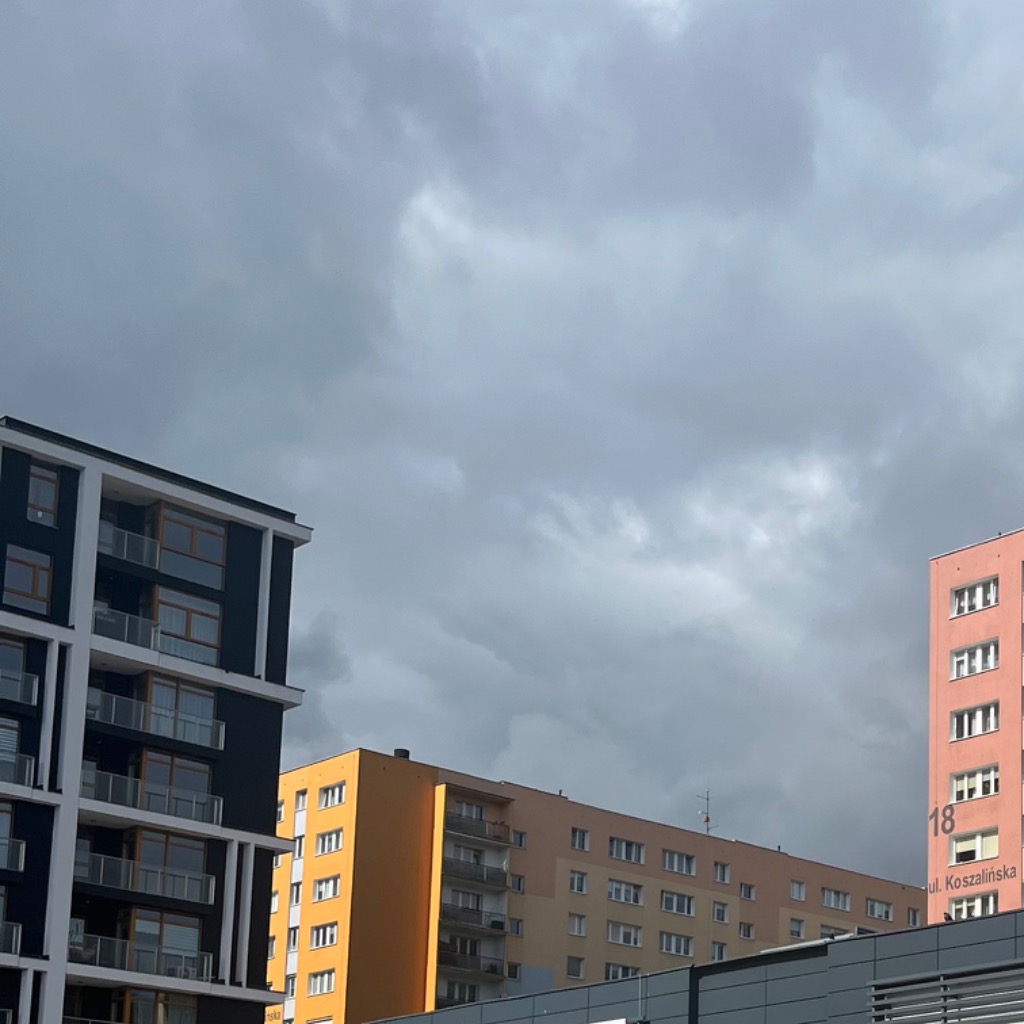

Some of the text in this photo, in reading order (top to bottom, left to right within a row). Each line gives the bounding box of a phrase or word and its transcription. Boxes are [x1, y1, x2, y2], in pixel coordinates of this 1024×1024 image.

[929, 804, 955, 836] 18
[929, 864, 1017, 893] ul. Koszalińska
